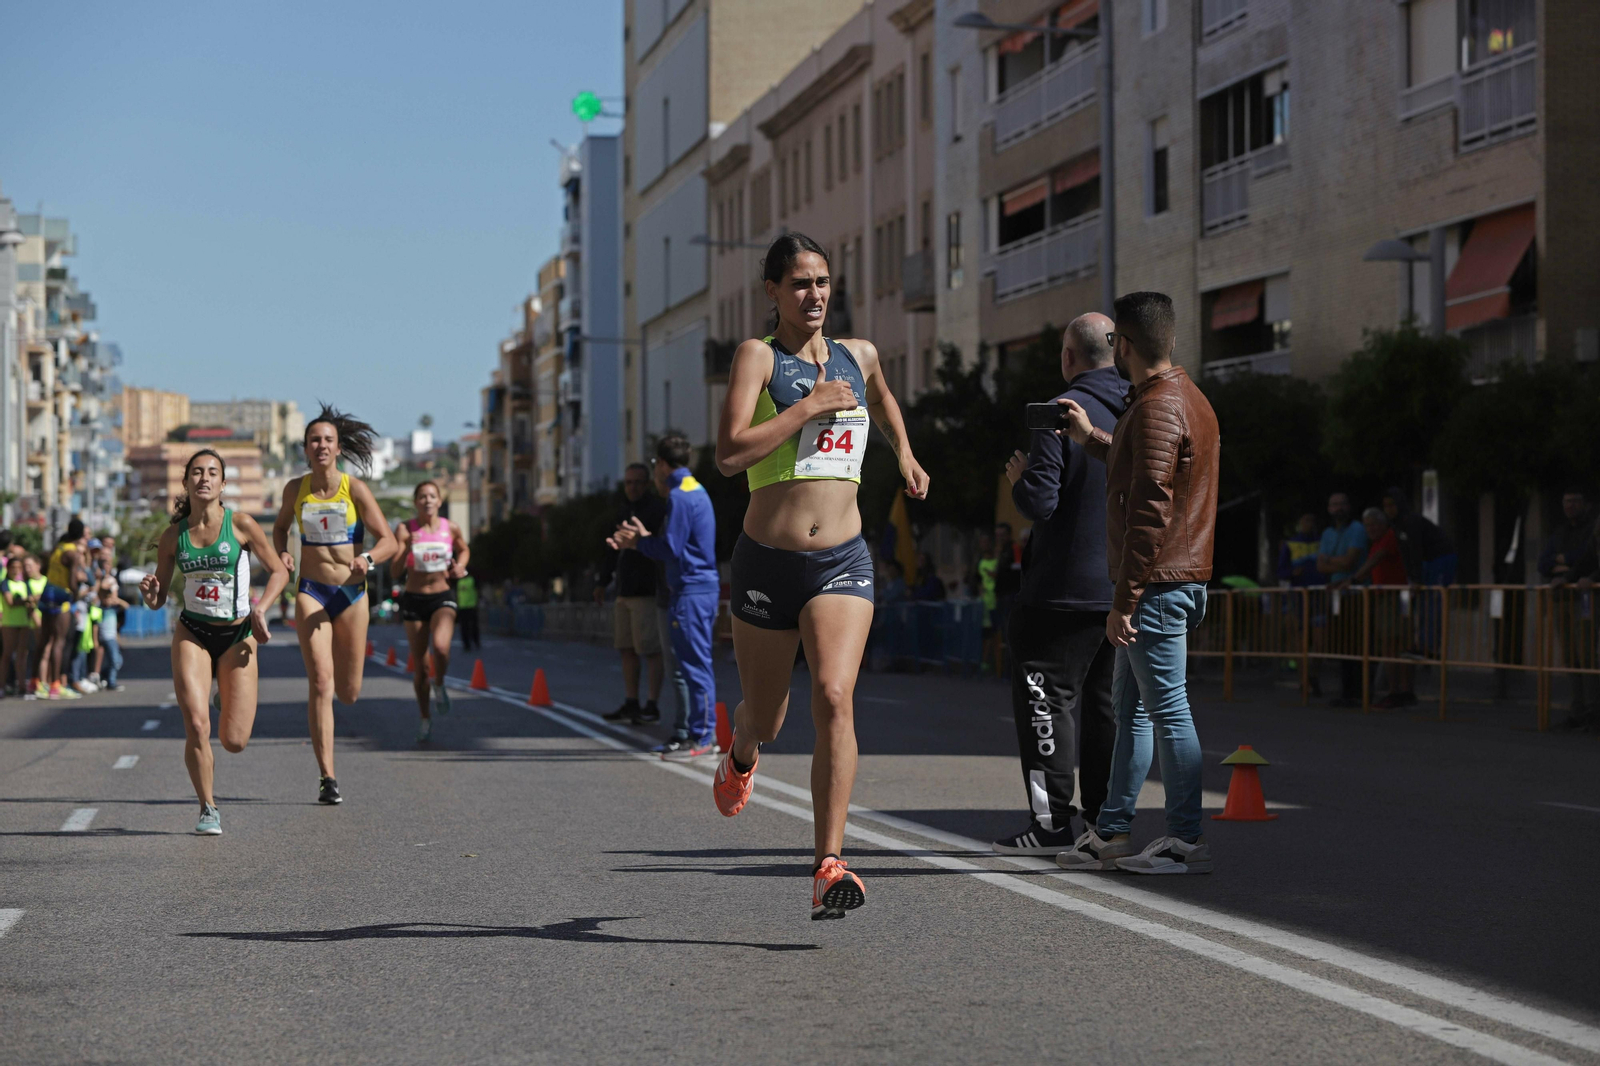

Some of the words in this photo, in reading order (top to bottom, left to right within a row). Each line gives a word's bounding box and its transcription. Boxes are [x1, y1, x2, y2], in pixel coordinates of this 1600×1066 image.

[816, 428, 854, 454] 64
[319, 516, 328, 531] 1
[181, 554, 229, 571] mijas
[195, 585, 220, 602] 44
[744, 602, 768, 614] Unicaja
[1026, 671, 1056, 757] adidas
